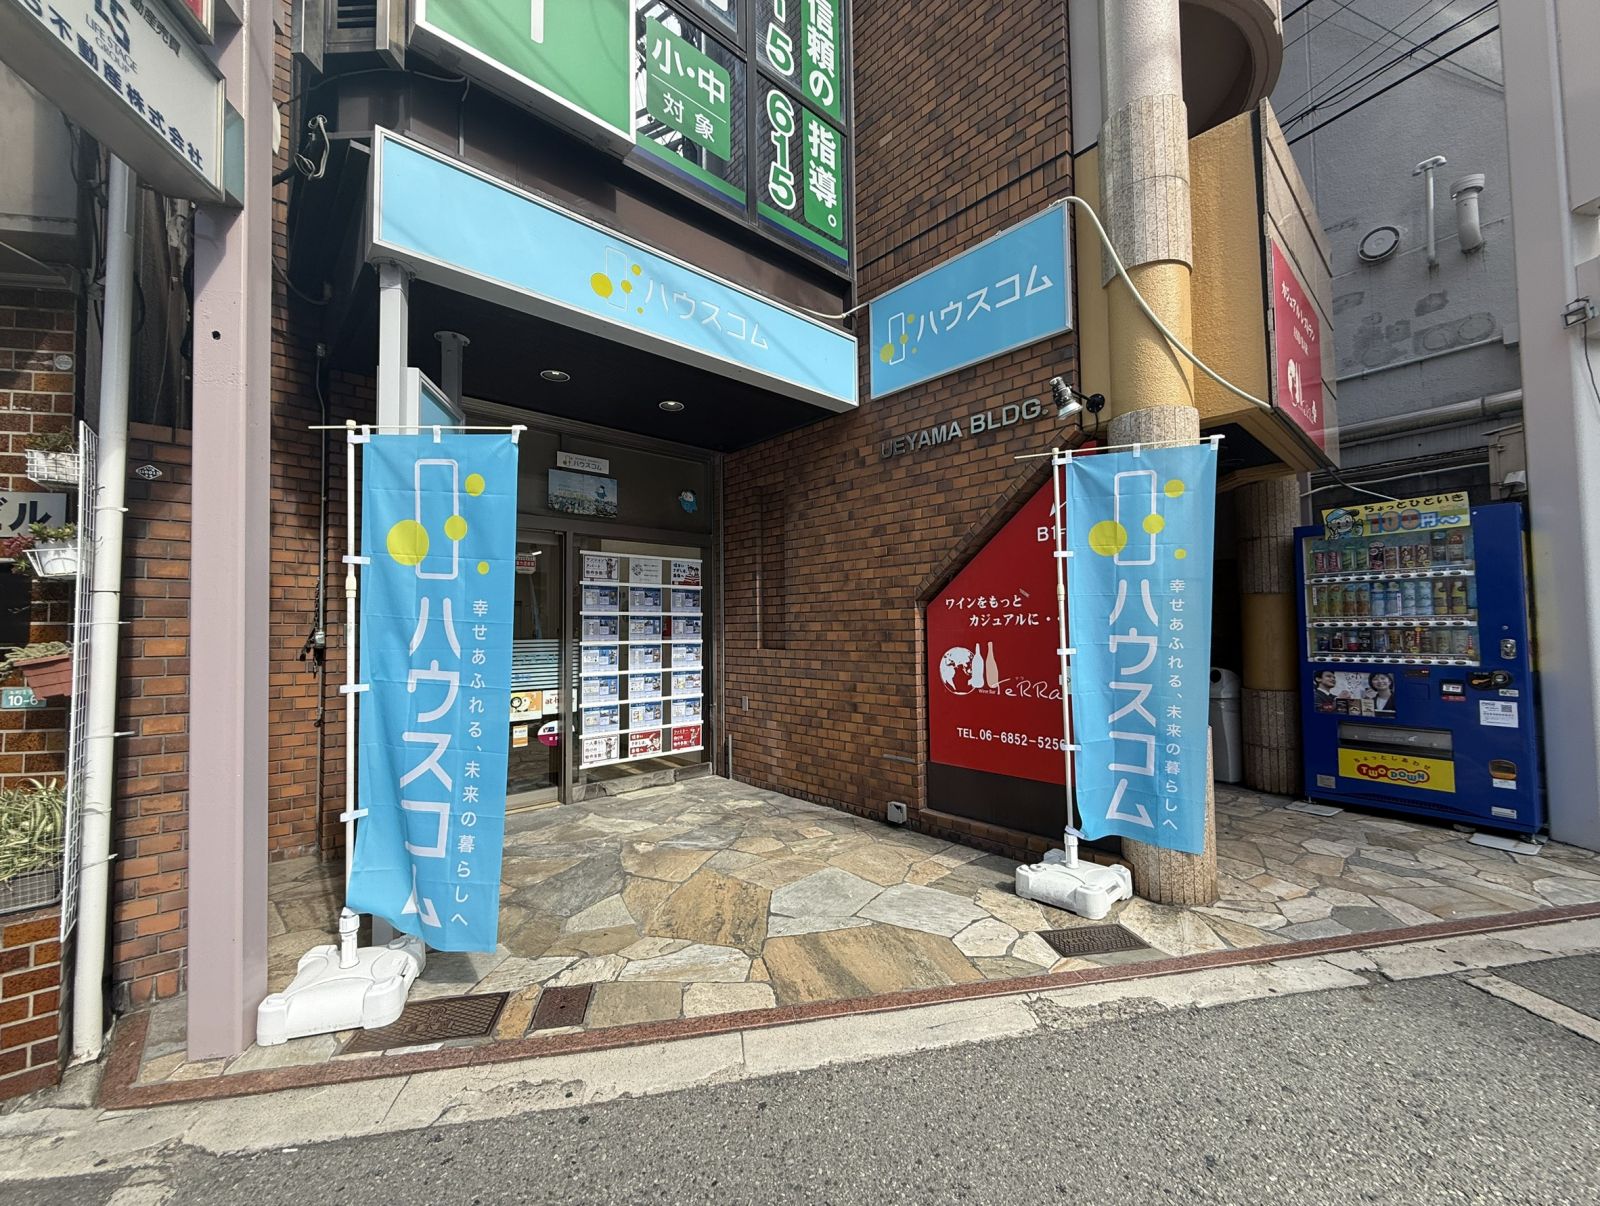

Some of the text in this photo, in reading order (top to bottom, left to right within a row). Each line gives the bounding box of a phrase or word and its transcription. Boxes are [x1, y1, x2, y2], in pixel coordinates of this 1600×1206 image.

[645, 279, 768, 349] ハウスコム
[917, 265, 1053, 342] ハウスコム
[881, 398, 1048, 459] UEYAMA BLDG.
[574, 460, 602, 471] ハウスコム
[0, 495, 52, 532] ル
[1364, 493, 1464, 513] ちょっとひといき
[945, 595, 1022, 609] ワインをもっと
[8, 695, 38, 706] 10-6
[1105, 579, 1159, 829] ハウスコム
[1163, 579, 1185, 830] 幸せあふれる、未来の暮らしへ
[400, 597, 461, 928] ハウスコム
[451, 599, 489, 927] 幸せあふれる、未来の暮らしへ
[1360, 765, 1426, 781] TWO DOWN
